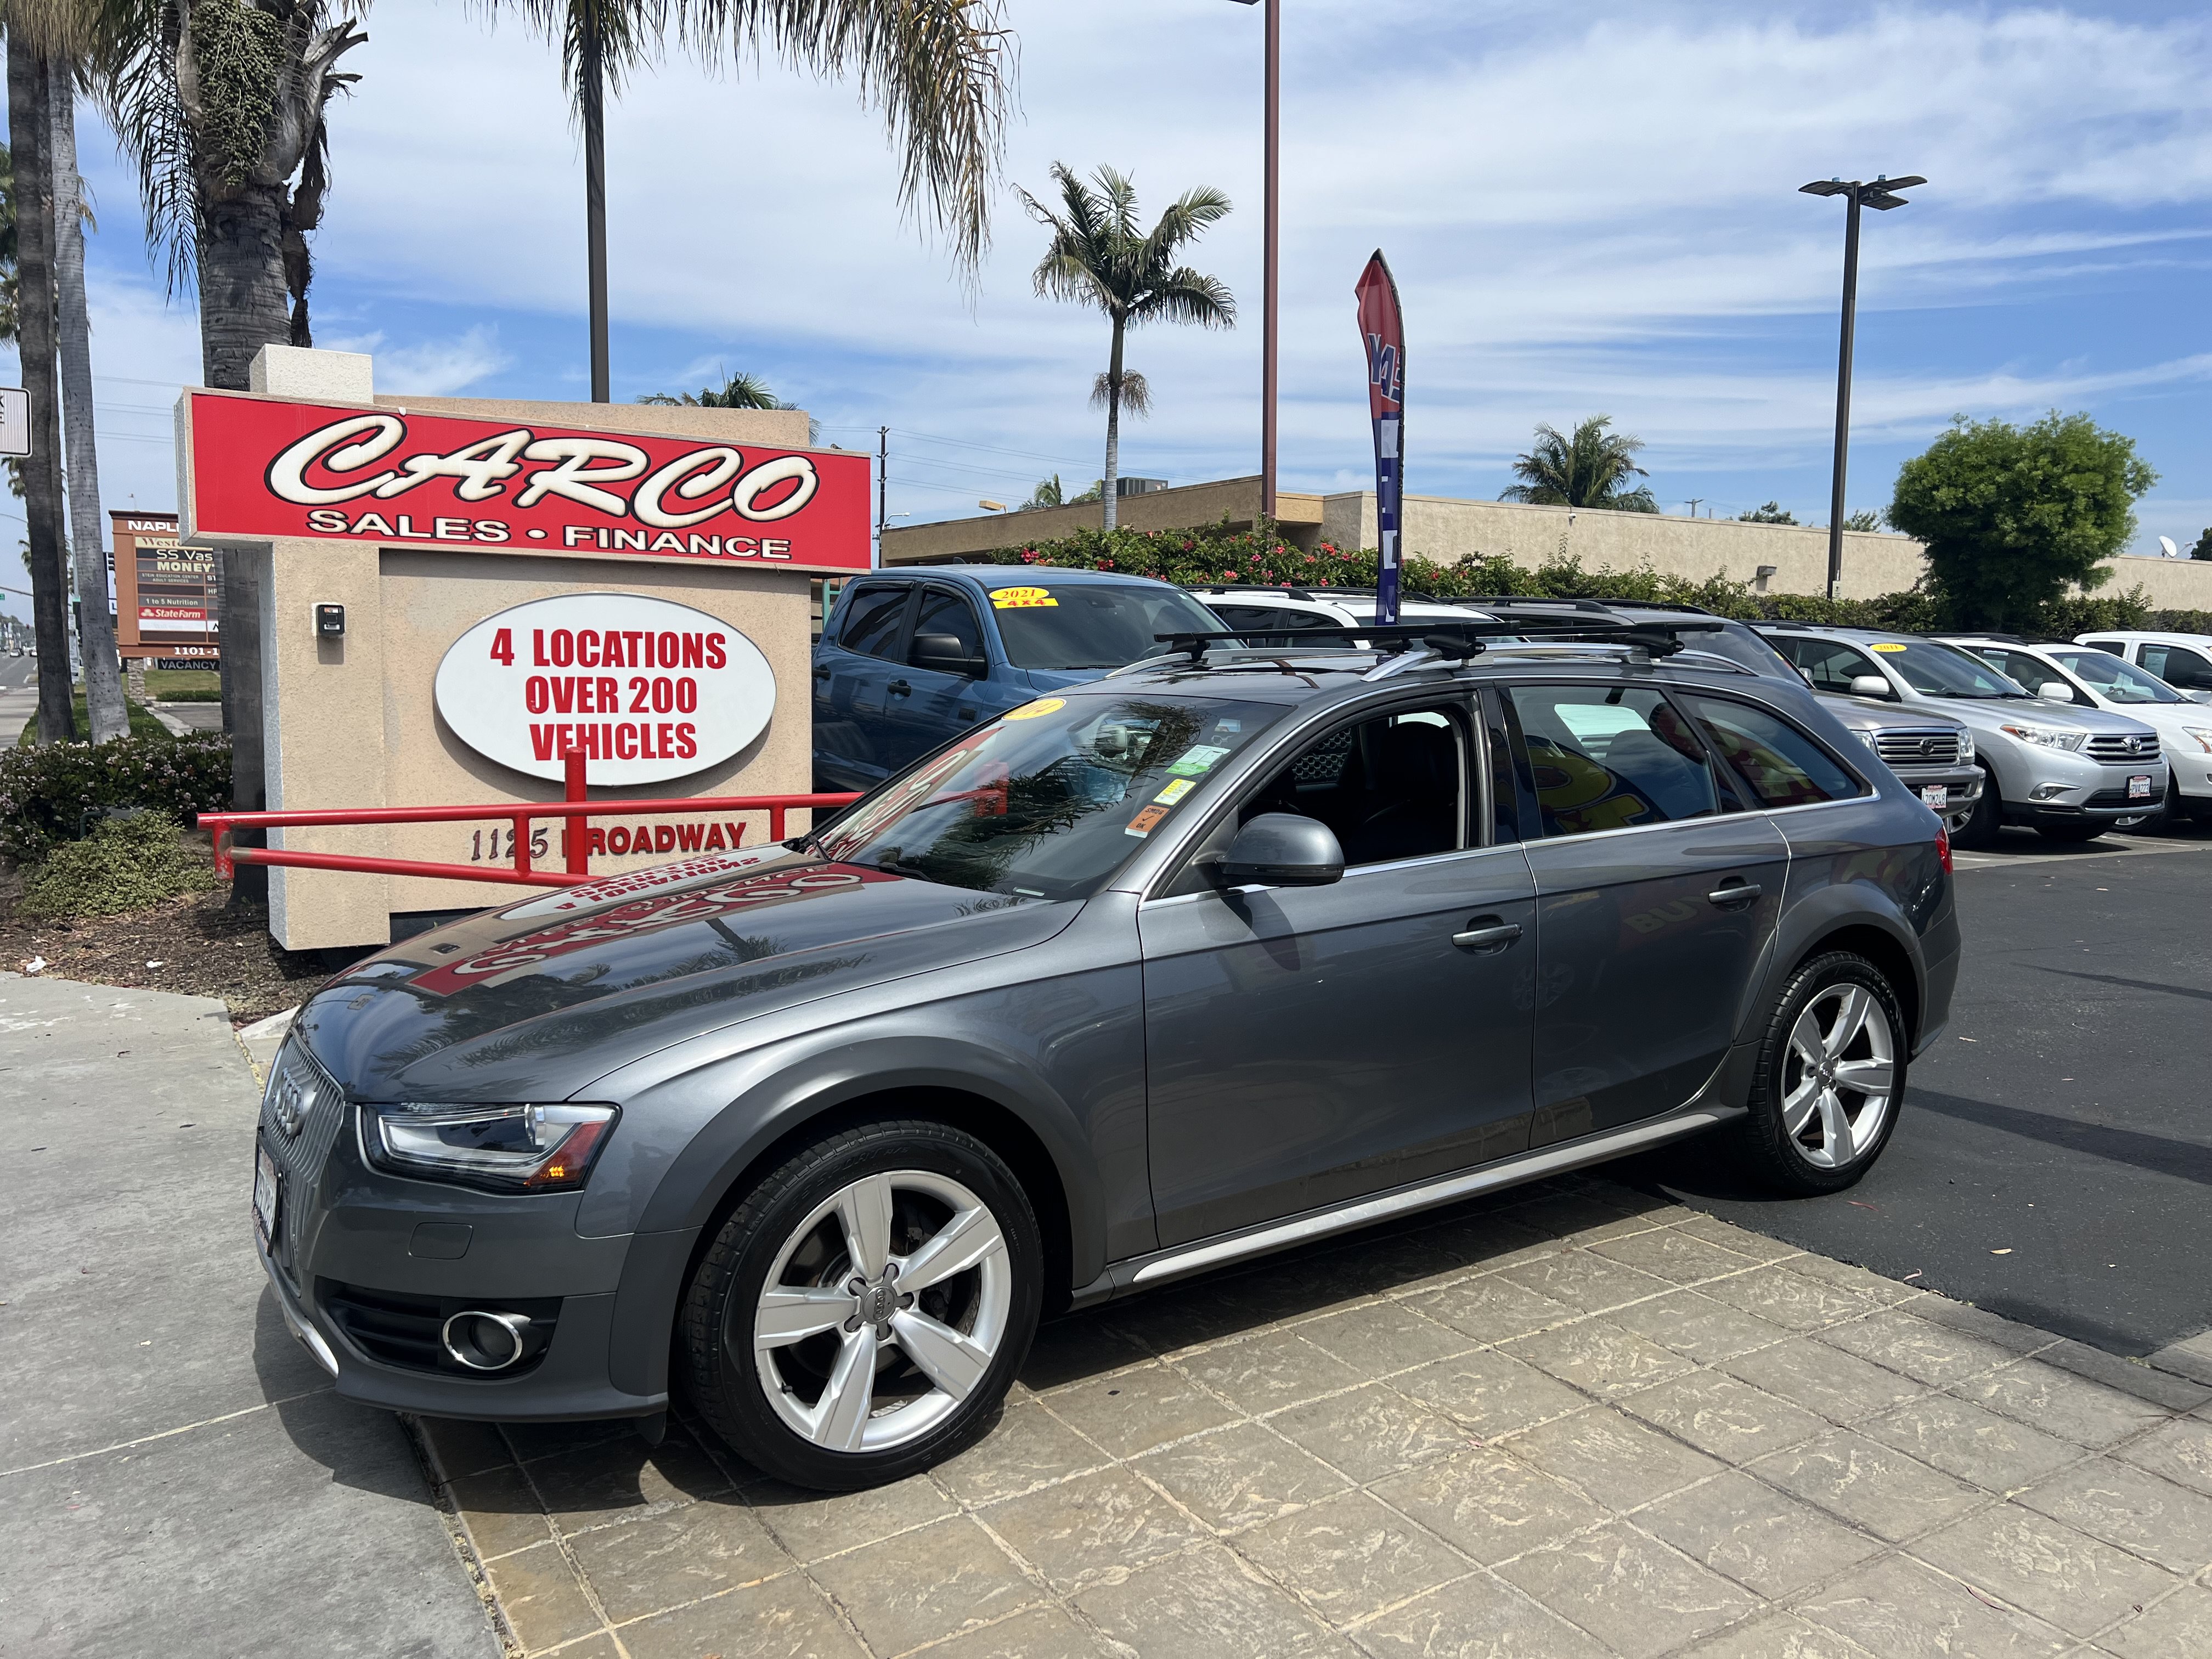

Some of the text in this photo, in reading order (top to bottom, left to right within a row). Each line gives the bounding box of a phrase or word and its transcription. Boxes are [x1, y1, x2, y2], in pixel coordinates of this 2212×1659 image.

[264, 414, 819, 528] CARCO
[128, 520, 179, 532] NAPL
[307, 510, 792, 560] SALES FINANCE
[157, 549, 179, 560] SS
[1002, 589, 1035, 599] 2021
[161, 661, 216, 669] VACANCY
[490, 628, 726, 669] 4 LOCATIONS
[525, 676, 697, 714] OVER 200
[529, 723, 697, 761] VEHICLES
[562, 822, 747, 857] ROADWAY
